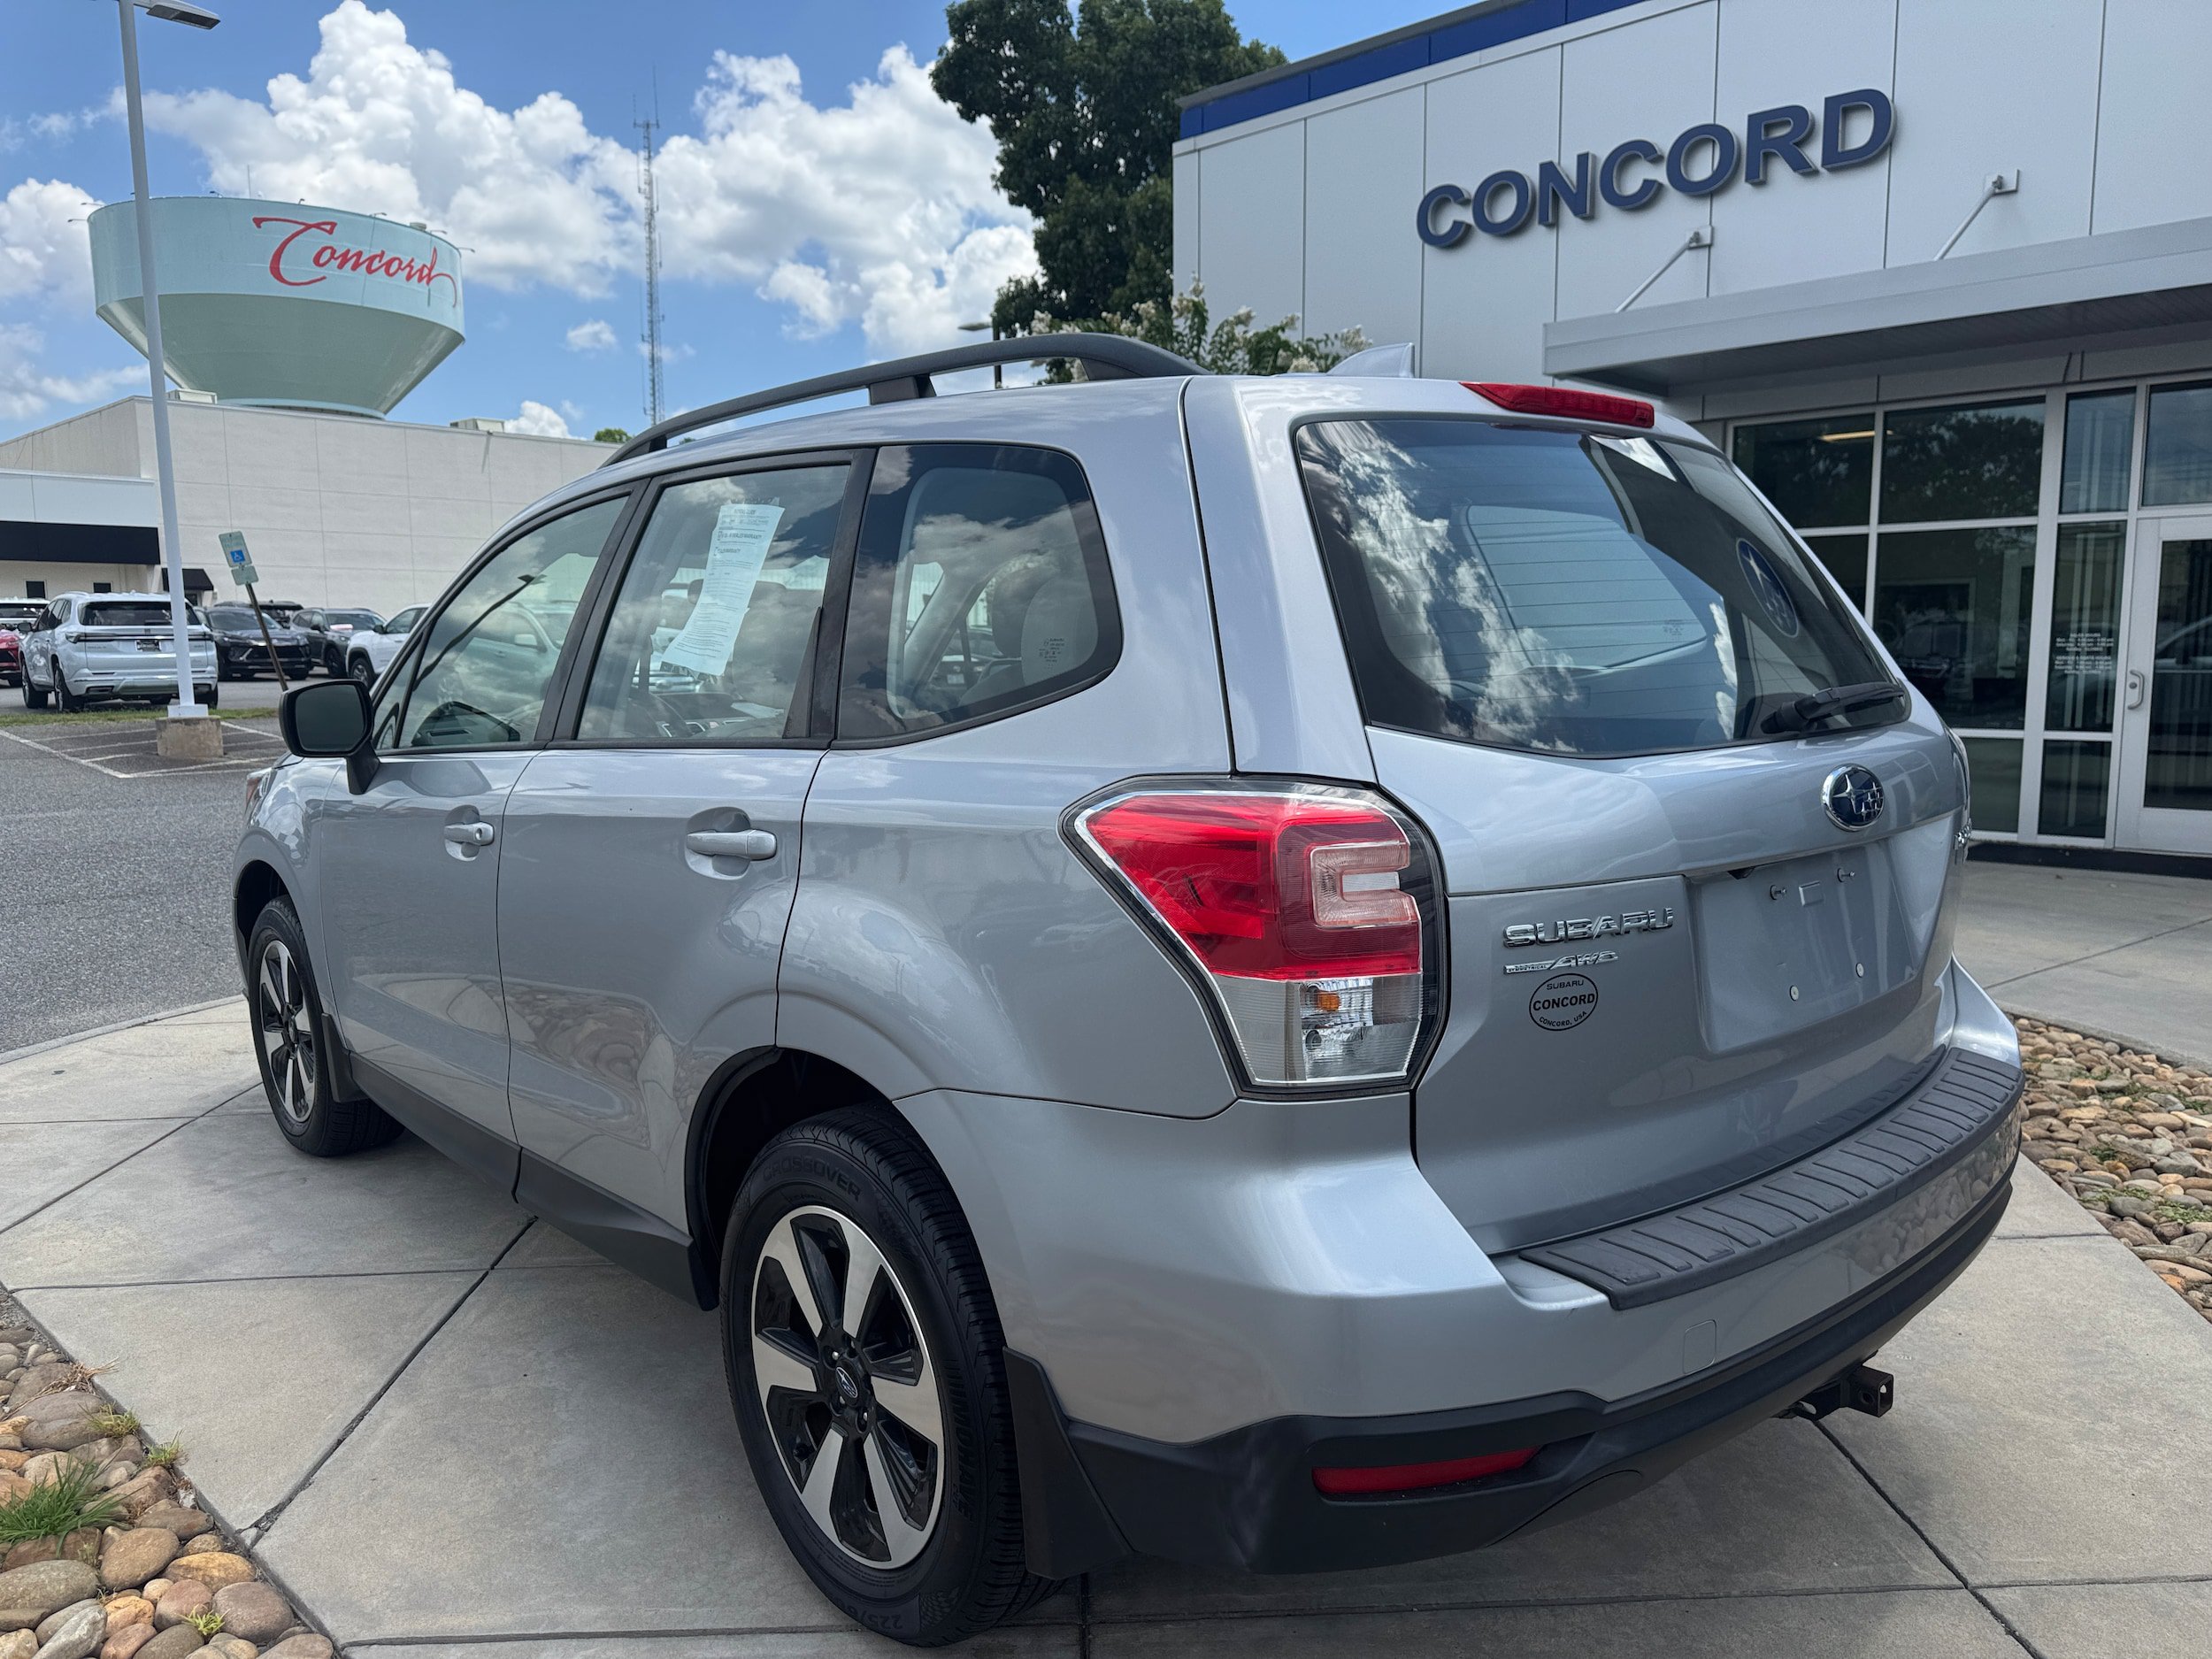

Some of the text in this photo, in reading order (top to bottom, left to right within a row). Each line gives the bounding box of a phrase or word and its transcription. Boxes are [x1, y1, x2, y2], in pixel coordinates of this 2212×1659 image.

[1416, 88, 1898, 248] CONCORD
[251, 217, 457, 308] Concord
[1503, 907, 1674, 948] SUBARU
[1548, 950, 1619, 971] AWD
[1546, 979, 1585, 991] SUBARU
[1532, 993, 1595, 1011] CONCORD
[1539, 1010, 1587, 1027] CONCORD, USA
[763, 1156, 862, 1202] CROSSOVER
